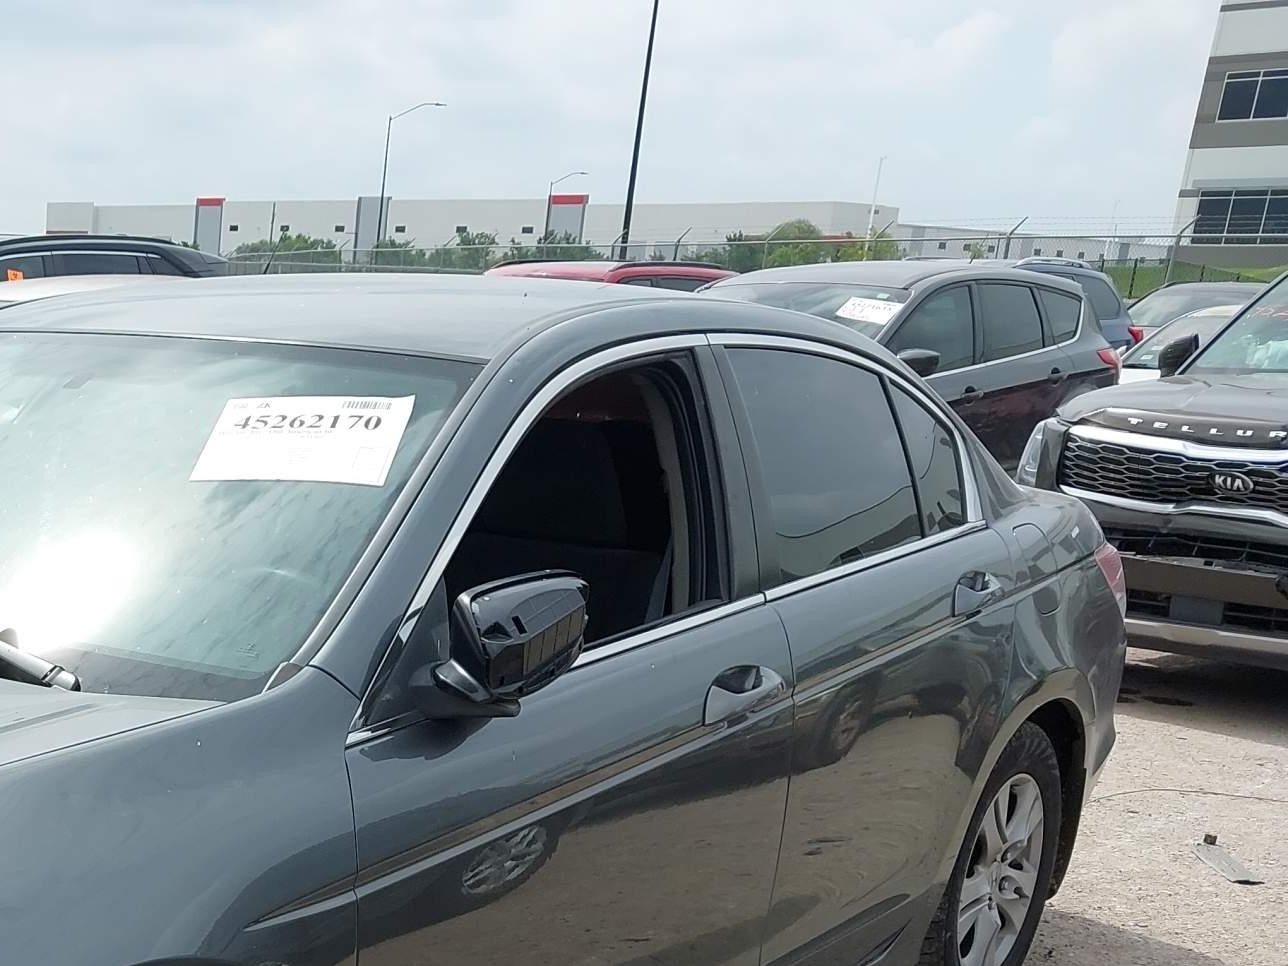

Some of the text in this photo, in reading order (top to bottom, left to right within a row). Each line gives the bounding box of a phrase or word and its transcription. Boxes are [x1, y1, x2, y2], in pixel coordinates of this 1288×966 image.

[234, 414, 382, 430] 45262170
[1127, 417, 1288, 438] TELLUR
[1214, 474, 1246, 491] KIA
